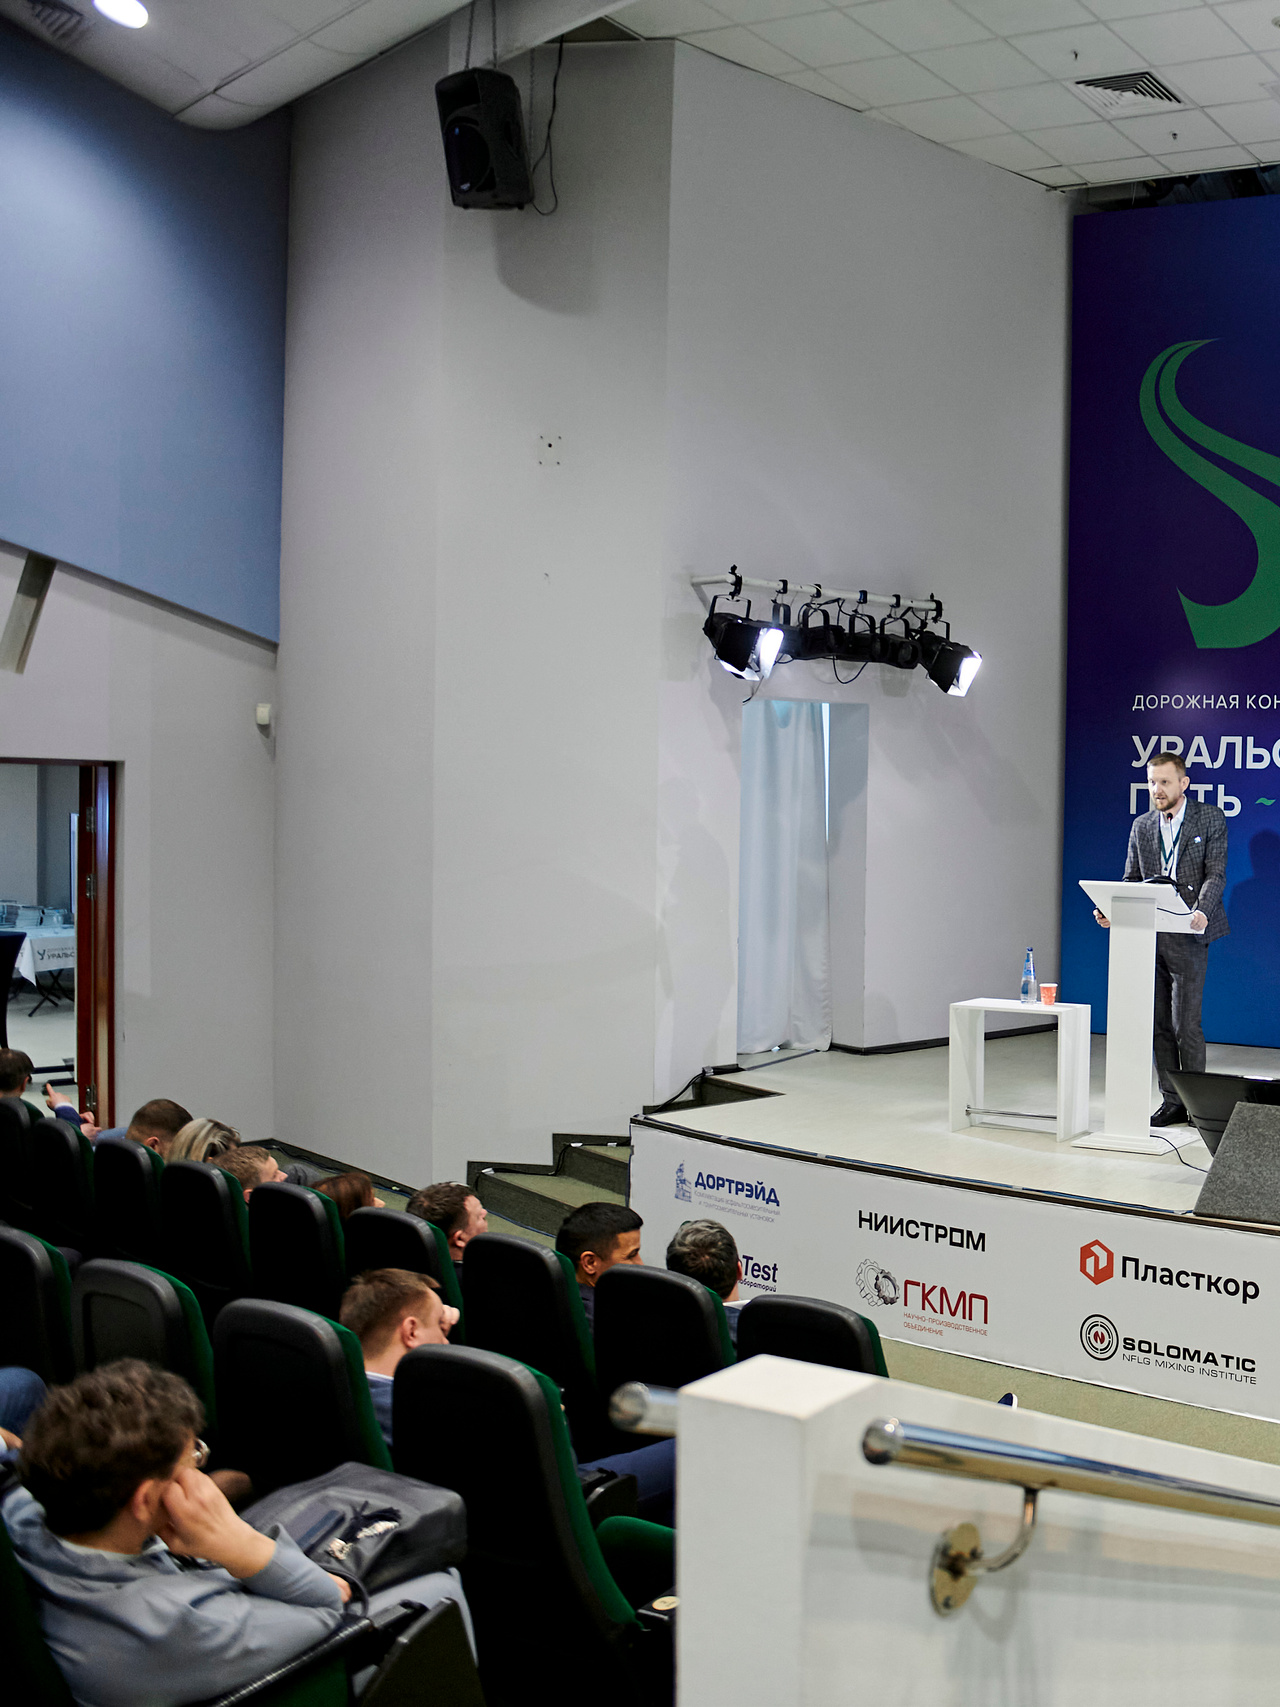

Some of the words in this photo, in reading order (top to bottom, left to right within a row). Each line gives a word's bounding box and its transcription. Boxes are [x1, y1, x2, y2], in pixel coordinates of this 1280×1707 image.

[1132, 694, 1239, 711] ДОРОЖНАЯ
[1129, 783, 1242, 817] ПТЬ
[694, 1171, 780, 1207] ДОРТРЭЙД
[858, 1209, 986, 1252] НИИСТРОМ
[1121, 1255, 1260, 1304] Пласткор
[904, 1279, 988, 1325] ГКМП
[903, 1312, 988, 1337] НАУЧНО-ПРОИЗВОДСТВЕННОЕ
[903, 1321, 944, 1337] ОБЪЕДИНЕНИЕ
[1122, 1336, 1256, 1373] SOLOMATIC
[1122, 1353, 1151, 1366] NFLG
[1154, 1359, 1195, 1374] MIXING
[1199, 1367, 1257, 1385] INSTITUTE
